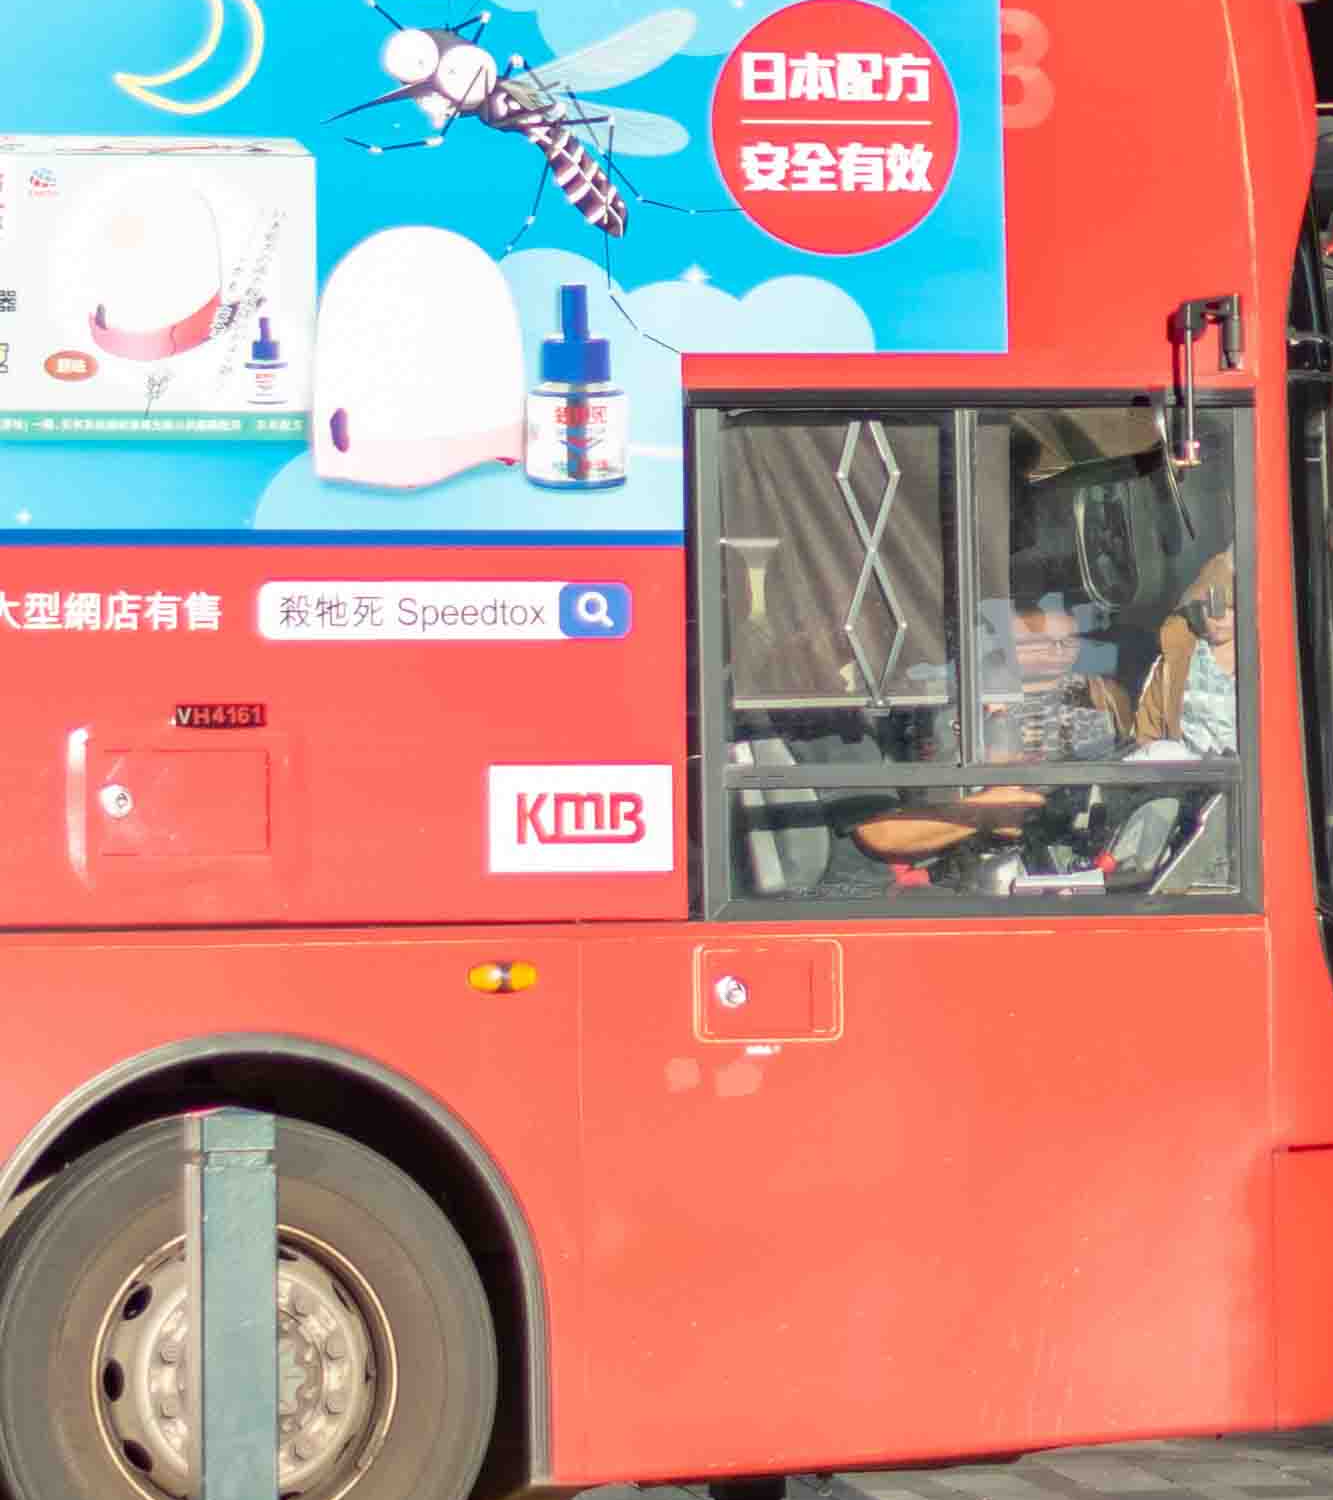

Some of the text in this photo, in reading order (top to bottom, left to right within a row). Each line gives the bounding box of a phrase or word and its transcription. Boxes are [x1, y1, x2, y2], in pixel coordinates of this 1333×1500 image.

[740, 51, 932, 101] 日本配方
[740, 142, 933, 192] 安全有效
[279, 595, 546, 631] 殺牠死 Speedtox
[516, 791, 648, 846] KMB
